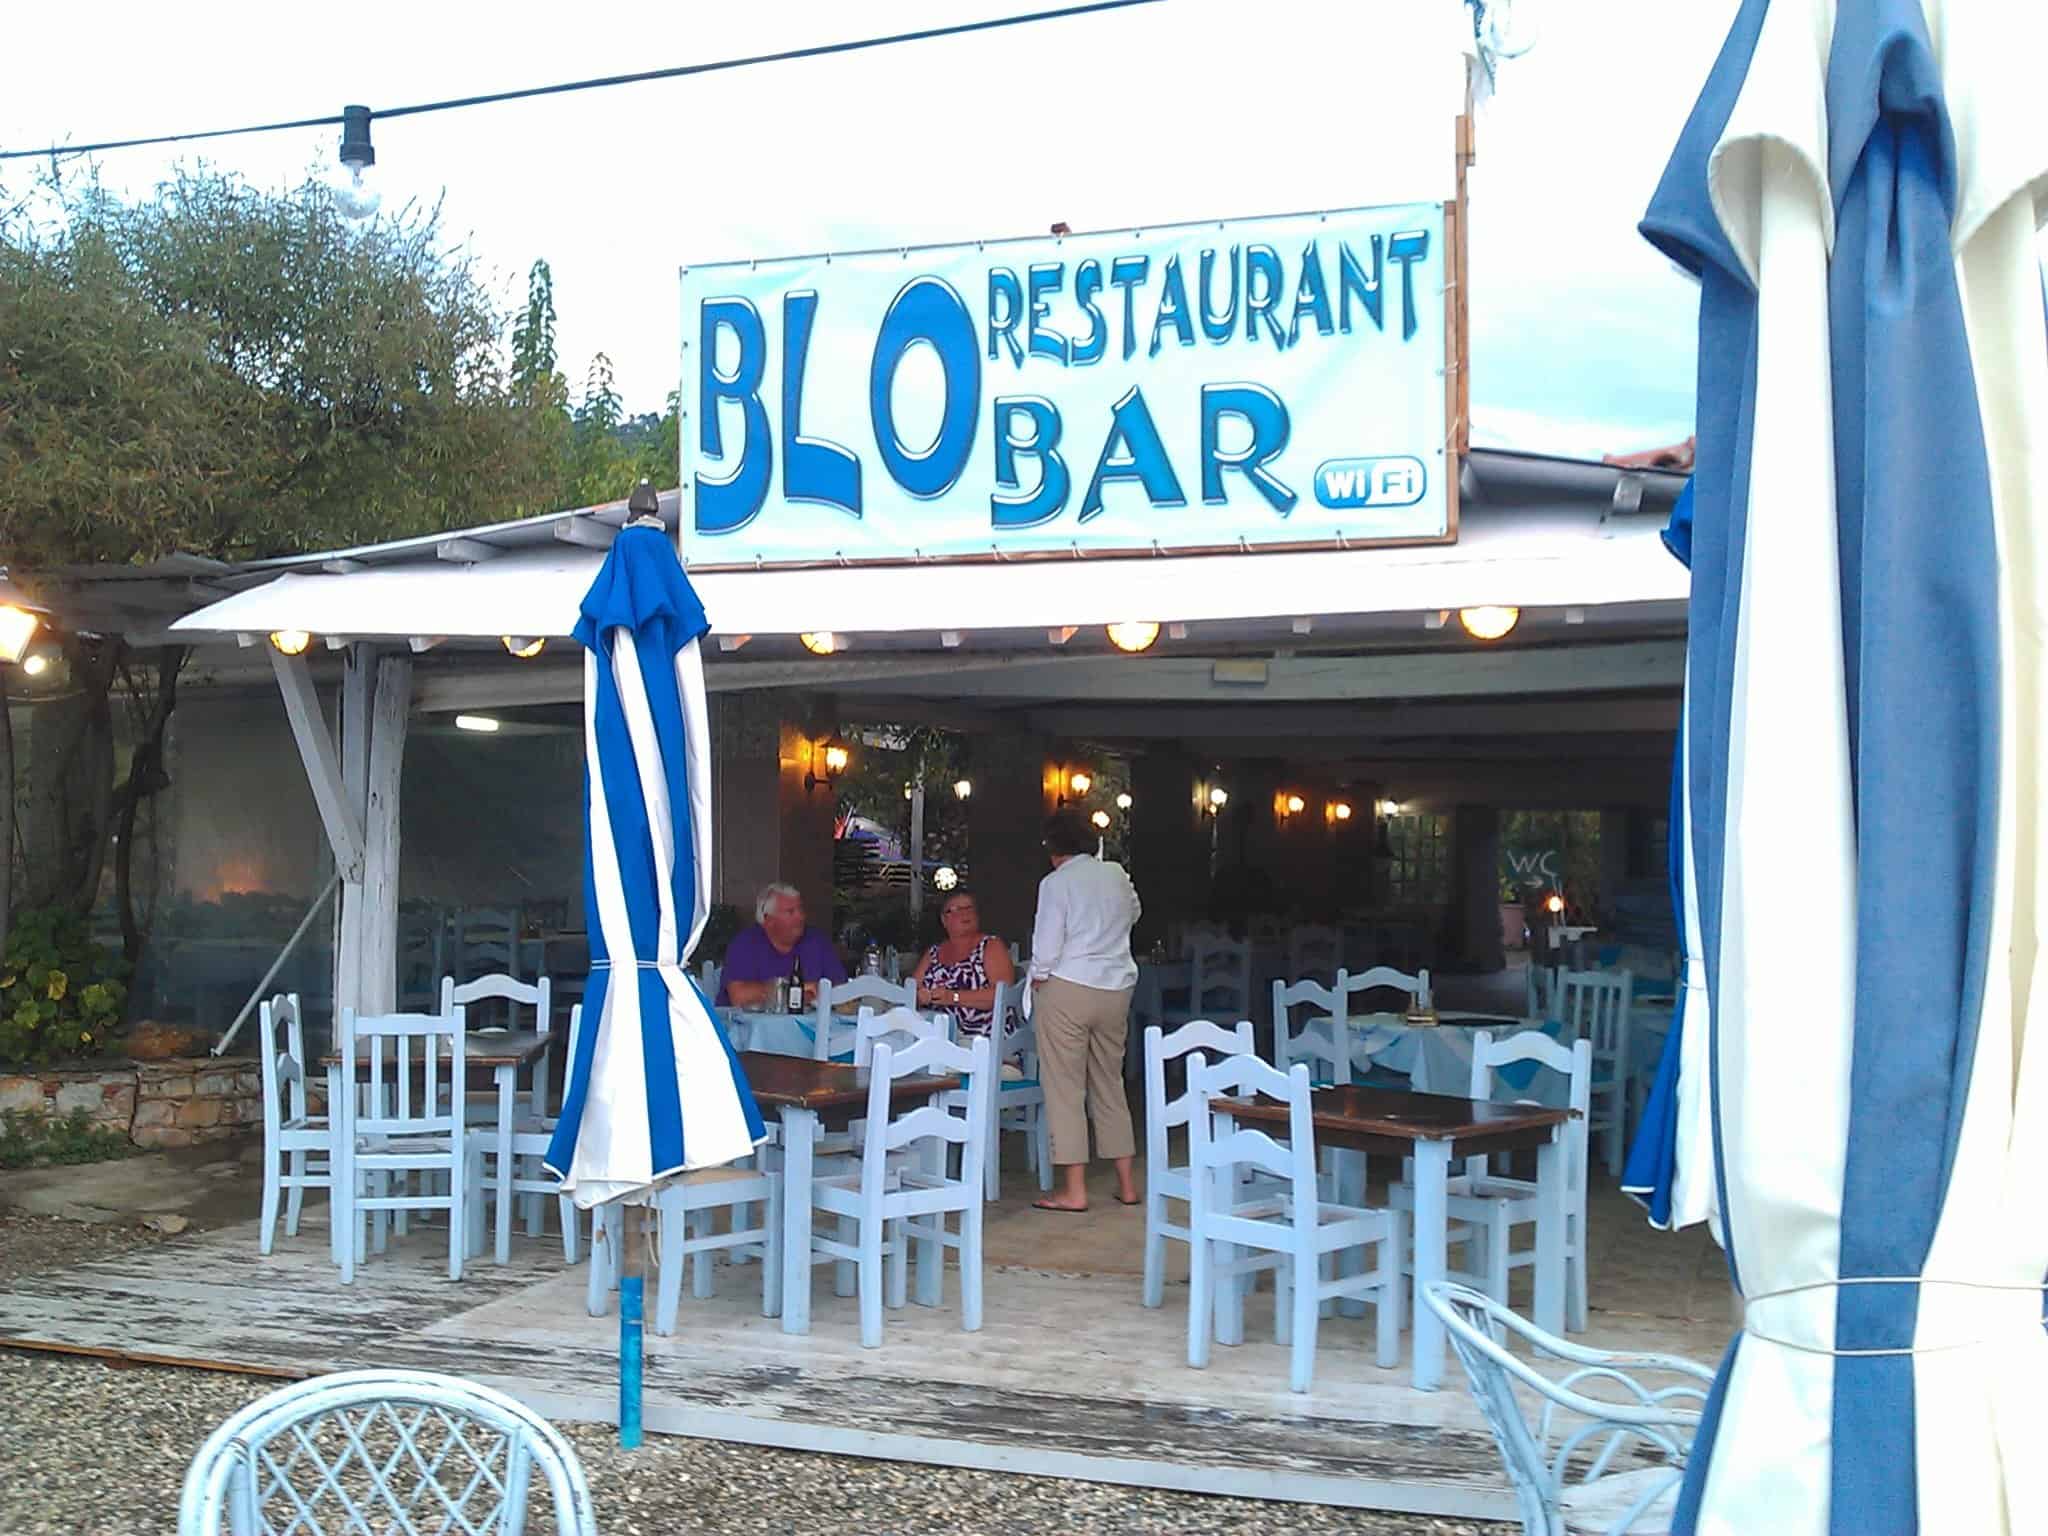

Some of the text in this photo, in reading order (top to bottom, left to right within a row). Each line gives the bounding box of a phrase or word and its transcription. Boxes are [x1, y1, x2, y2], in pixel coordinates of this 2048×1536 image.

[988, 229, 1429, 368] RESTAURANT
[694, 275, 982, 535] BLO
[990, 381, 1298, 529] BAR
[1506, 849, 1557, 877] WC
